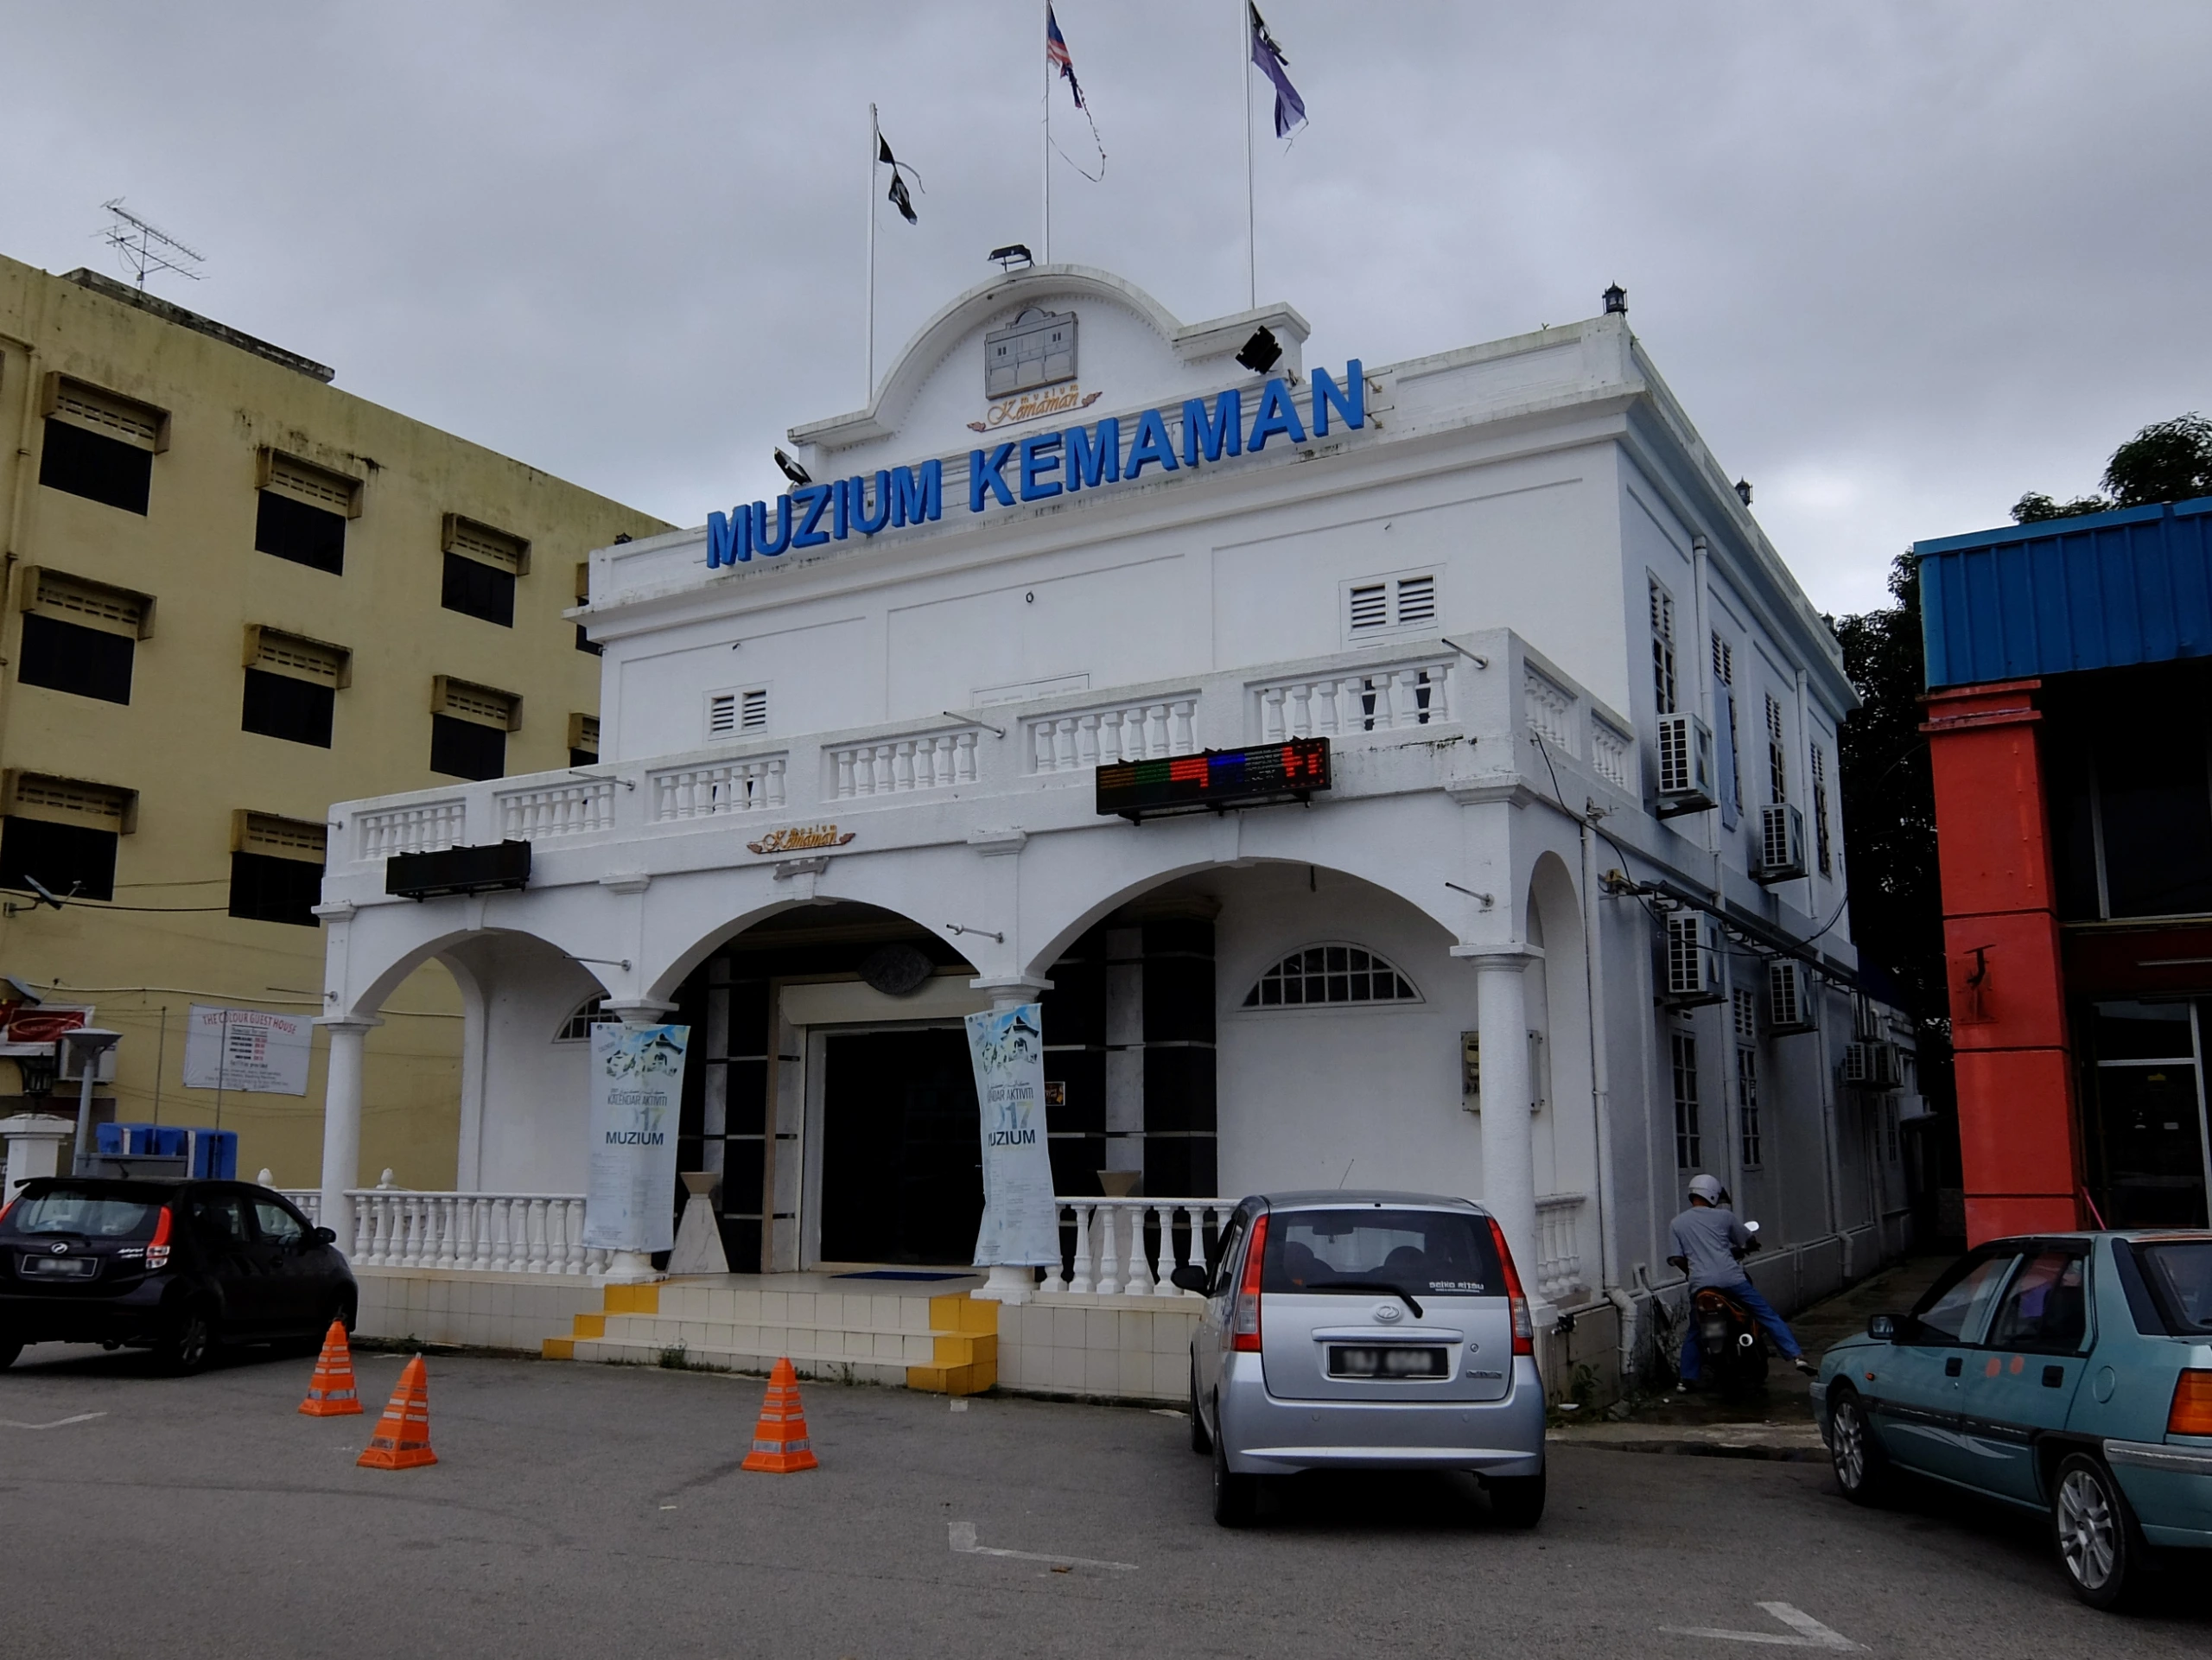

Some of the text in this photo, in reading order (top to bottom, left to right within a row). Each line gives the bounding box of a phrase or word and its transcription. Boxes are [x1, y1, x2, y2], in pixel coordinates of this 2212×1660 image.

[706, 358, 1365, 569] MUZIUM KEMAMAN
[201, 1014, 217, 1026] THE
[250, 1013, 273, 1027] GUEST
[273, 1018, 298, 1034] HOUSE
[606, 1131, 664, 1146] MUZIUM
